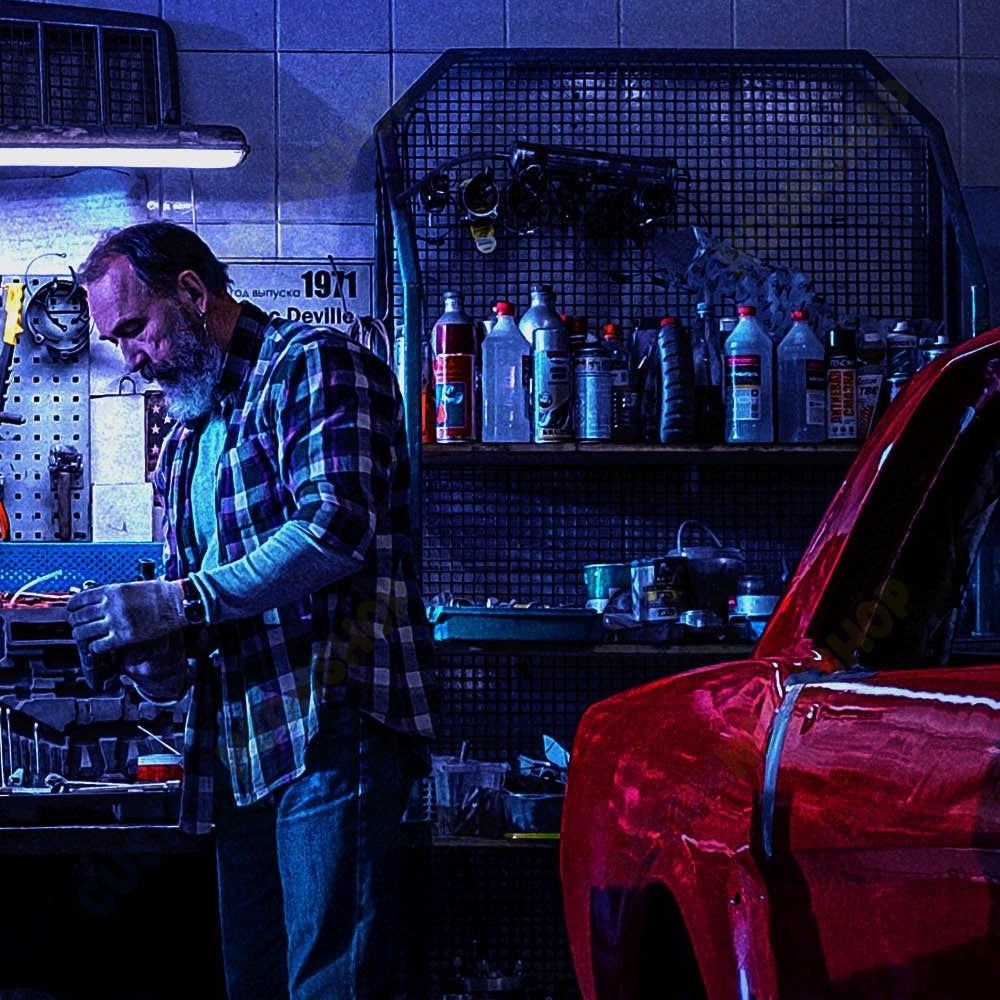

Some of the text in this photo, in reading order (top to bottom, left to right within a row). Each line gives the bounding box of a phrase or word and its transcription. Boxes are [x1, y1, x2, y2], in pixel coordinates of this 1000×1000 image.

[252, 288, 301, 300] выпуска
[301, 269, 357, 299] 1971
[287, 306, 355, 325] Deville
